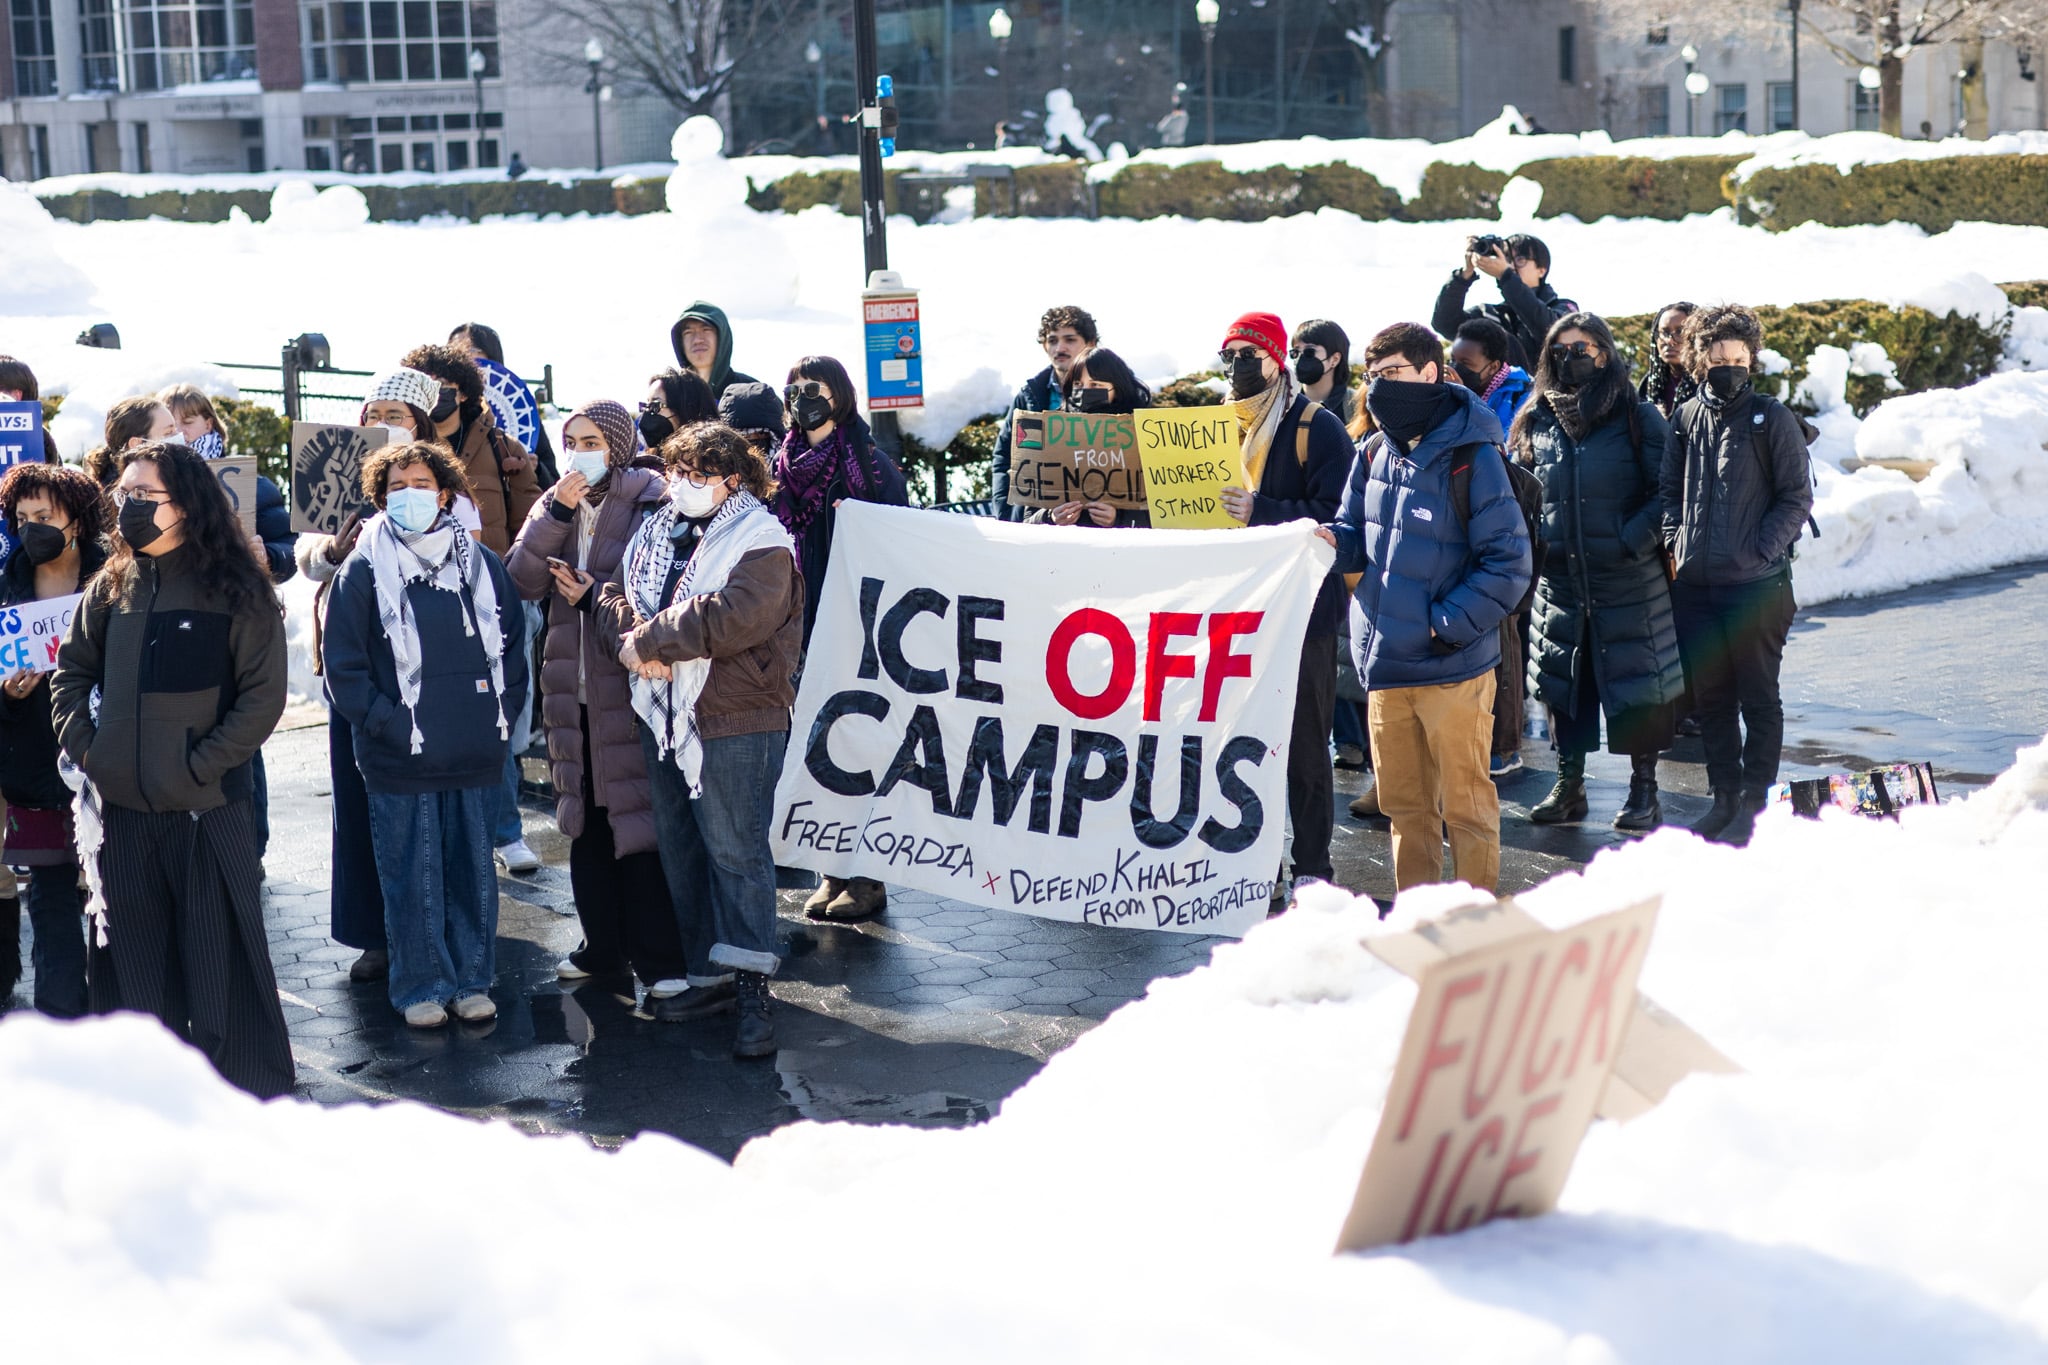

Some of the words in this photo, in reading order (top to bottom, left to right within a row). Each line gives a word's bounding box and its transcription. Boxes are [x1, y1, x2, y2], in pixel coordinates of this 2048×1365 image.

[1047, 415, 1135, 449] DIVES
[1142, 419, 1230, 449] STUDENT
[1074, 449, 1125, 468] FROM
[1149, 460, 1231, 485] WORKERS
[1155, 497, 1215, 518] STAND
[33, 616, 57, 635] OFF
[0, 636, 34, 675] CE
[857, 577, 1005, 705] ICE
[1046, 608, 1266, 722] OFF
[804, 690, 1268, 853] CAMPUS
[782, 801, 857, 853] FREE
[856, 808, 973, 878] KORDIA
[1010, 869, 1107, 905] DEFEND
[1111, 848, 1218, 894] KHALIL
[1152, 876, 1276, 927] DEPORTATION
[1397, 927, 1641, 1141] FUCK
[1399, 1092, 1564, 1245] ICE
